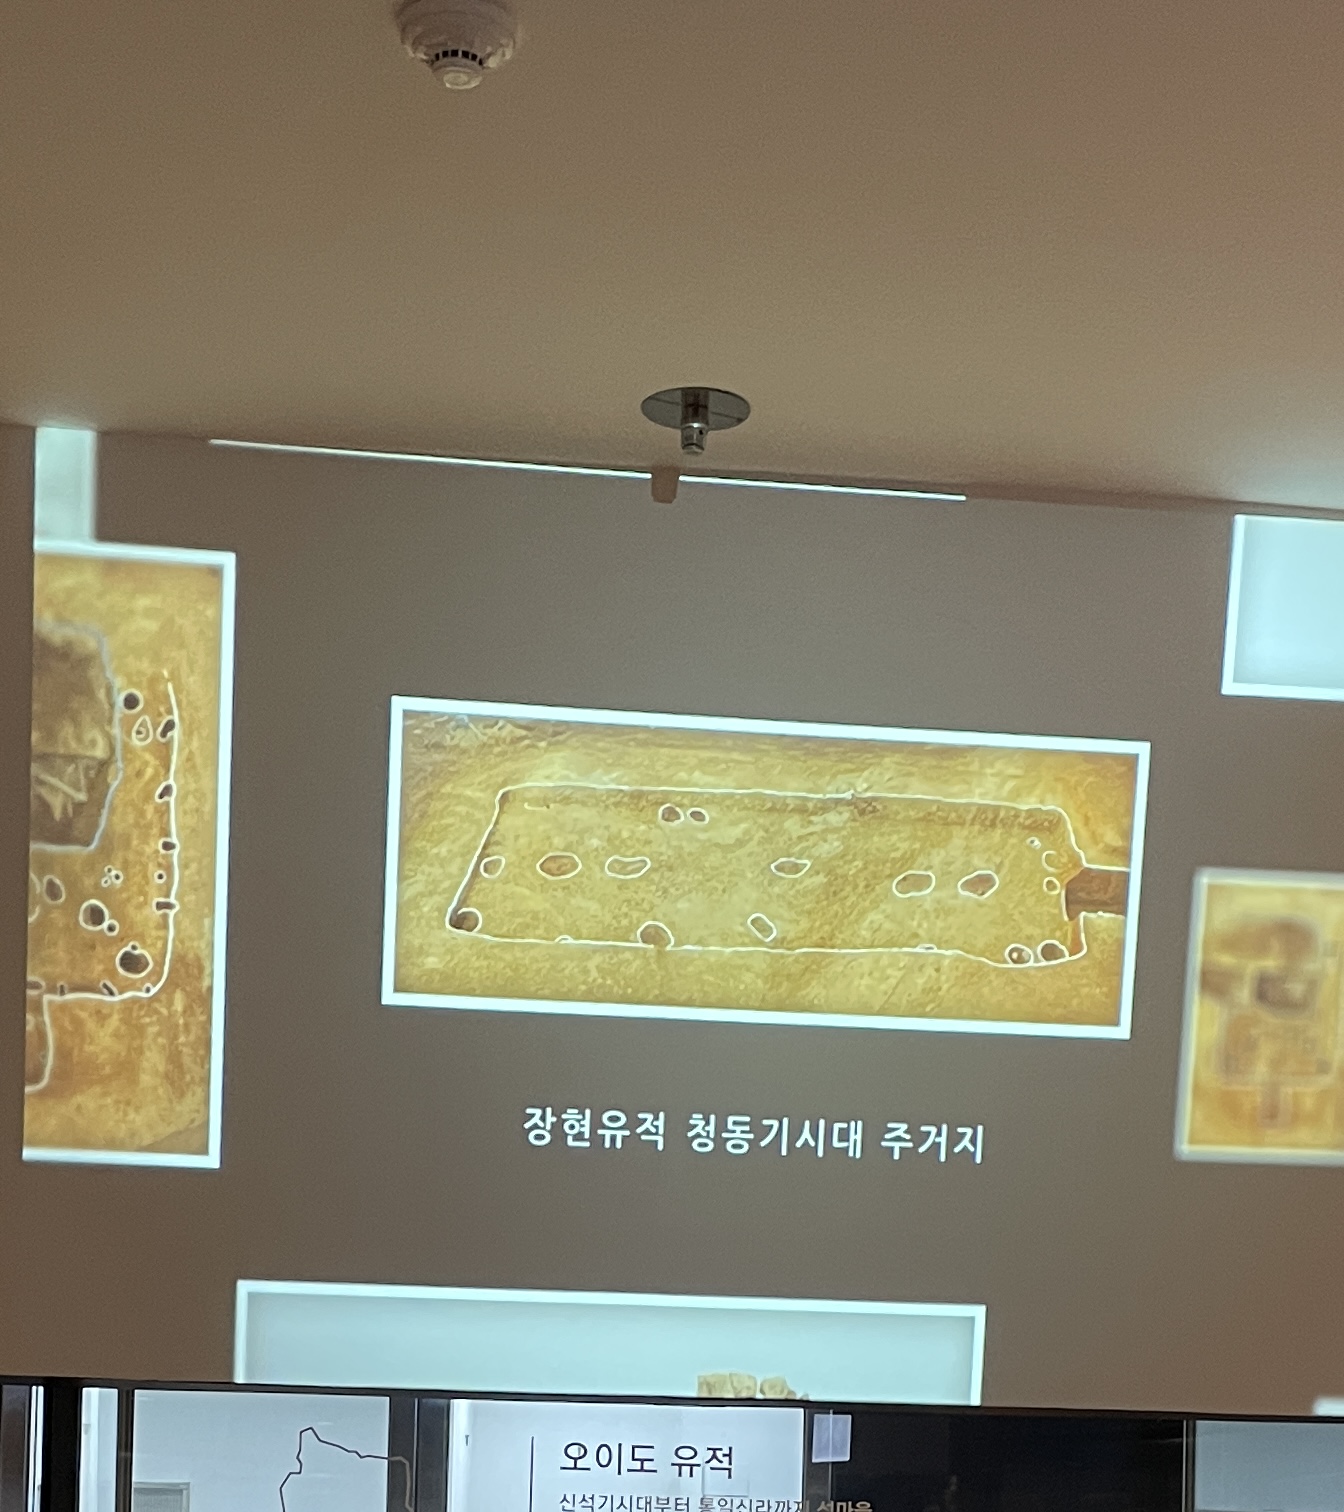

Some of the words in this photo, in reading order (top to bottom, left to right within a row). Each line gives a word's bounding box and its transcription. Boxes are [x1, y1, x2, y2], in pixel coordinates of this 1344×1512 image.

[523, 1107, 666, 1151] 장현유적
[687, 1113, 862, 1159] 청동기시대
[880, 1121, 985, 1164] 주거지
[560, 1442, 657, 1475] 오이도
[671, 1445, 733, 1479] 유적
